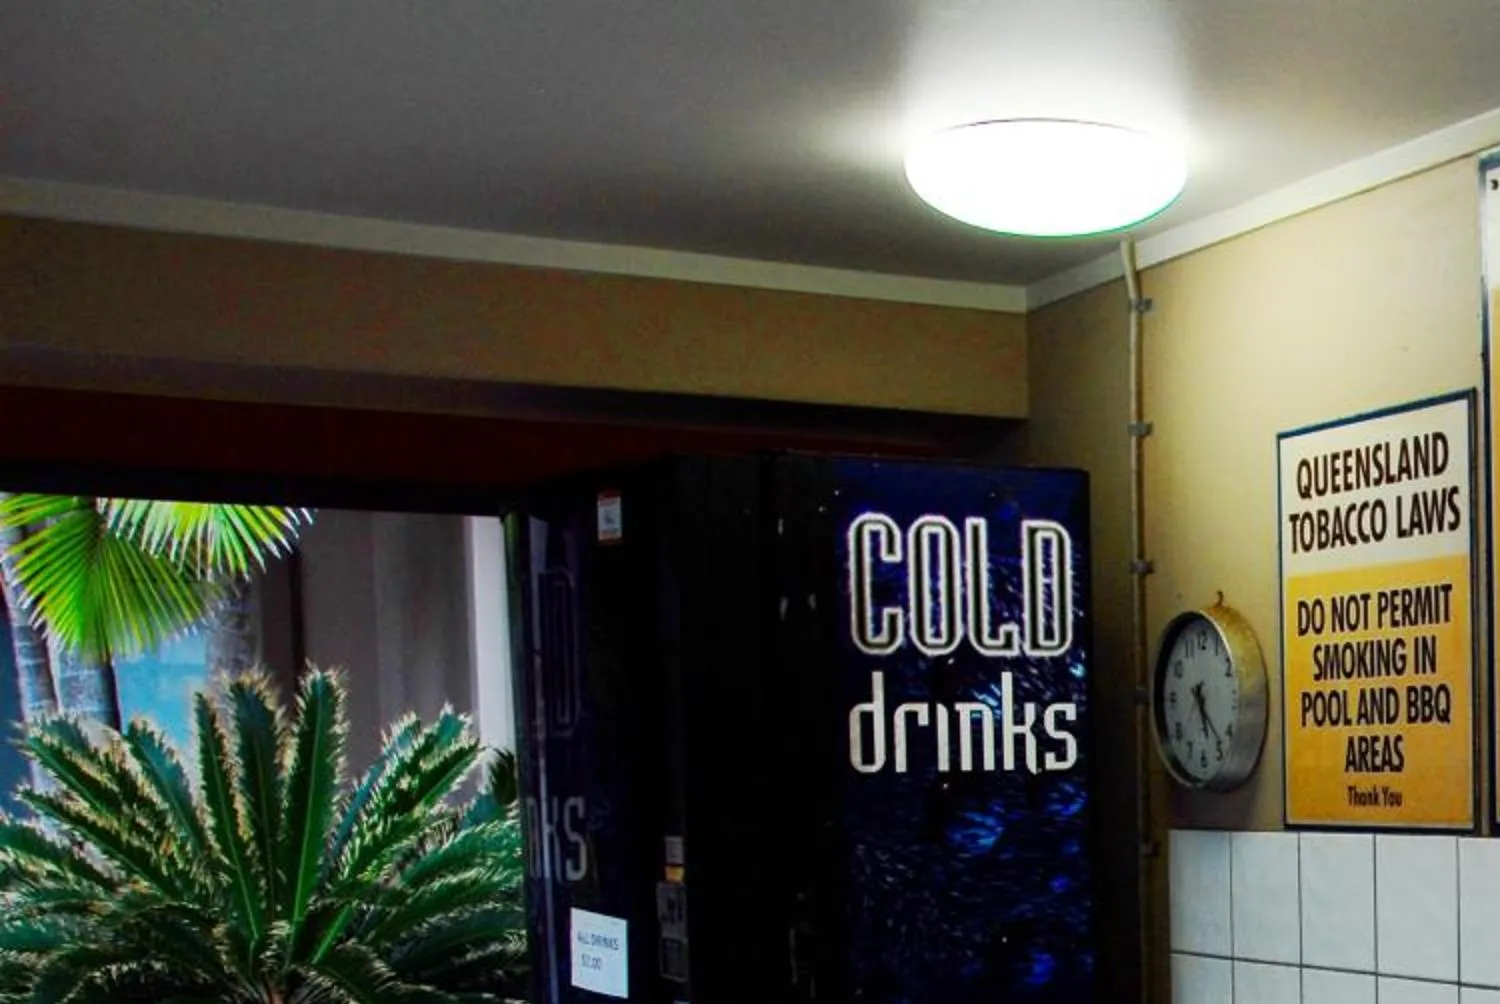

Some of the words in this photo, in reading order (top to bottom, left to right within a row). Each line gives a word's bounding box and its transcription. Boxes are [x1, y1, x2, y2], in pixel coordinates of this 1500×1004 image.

[1296, 431, 1448, 500] QUEENSLAND
[1289, 499, 1387, 554] TOBACCO
[1397, 486, 1461, 539] LAWS
[848, 512, 1073, 656] COLD
[1297, 598, 1325, 636] DO
[1331, 593, 1371, 633] NOT
[1377, 583, 1452, 629] PERMIT
[1313, 637, 1406, 681] SMOKING
[1414, 635, 1436, 675] IN
[849, 671, 1077, 775] drinks
[1301, 690, 1352, 727] POOL
[1357, 687, 1400, 725] AND
[1406, 683, 1451, 724] BBQ
[1344, 734, 1405, 773] AREAS
[1347, 784, 1379, 807] Thank
[1382, 786, 1403, 807] You
